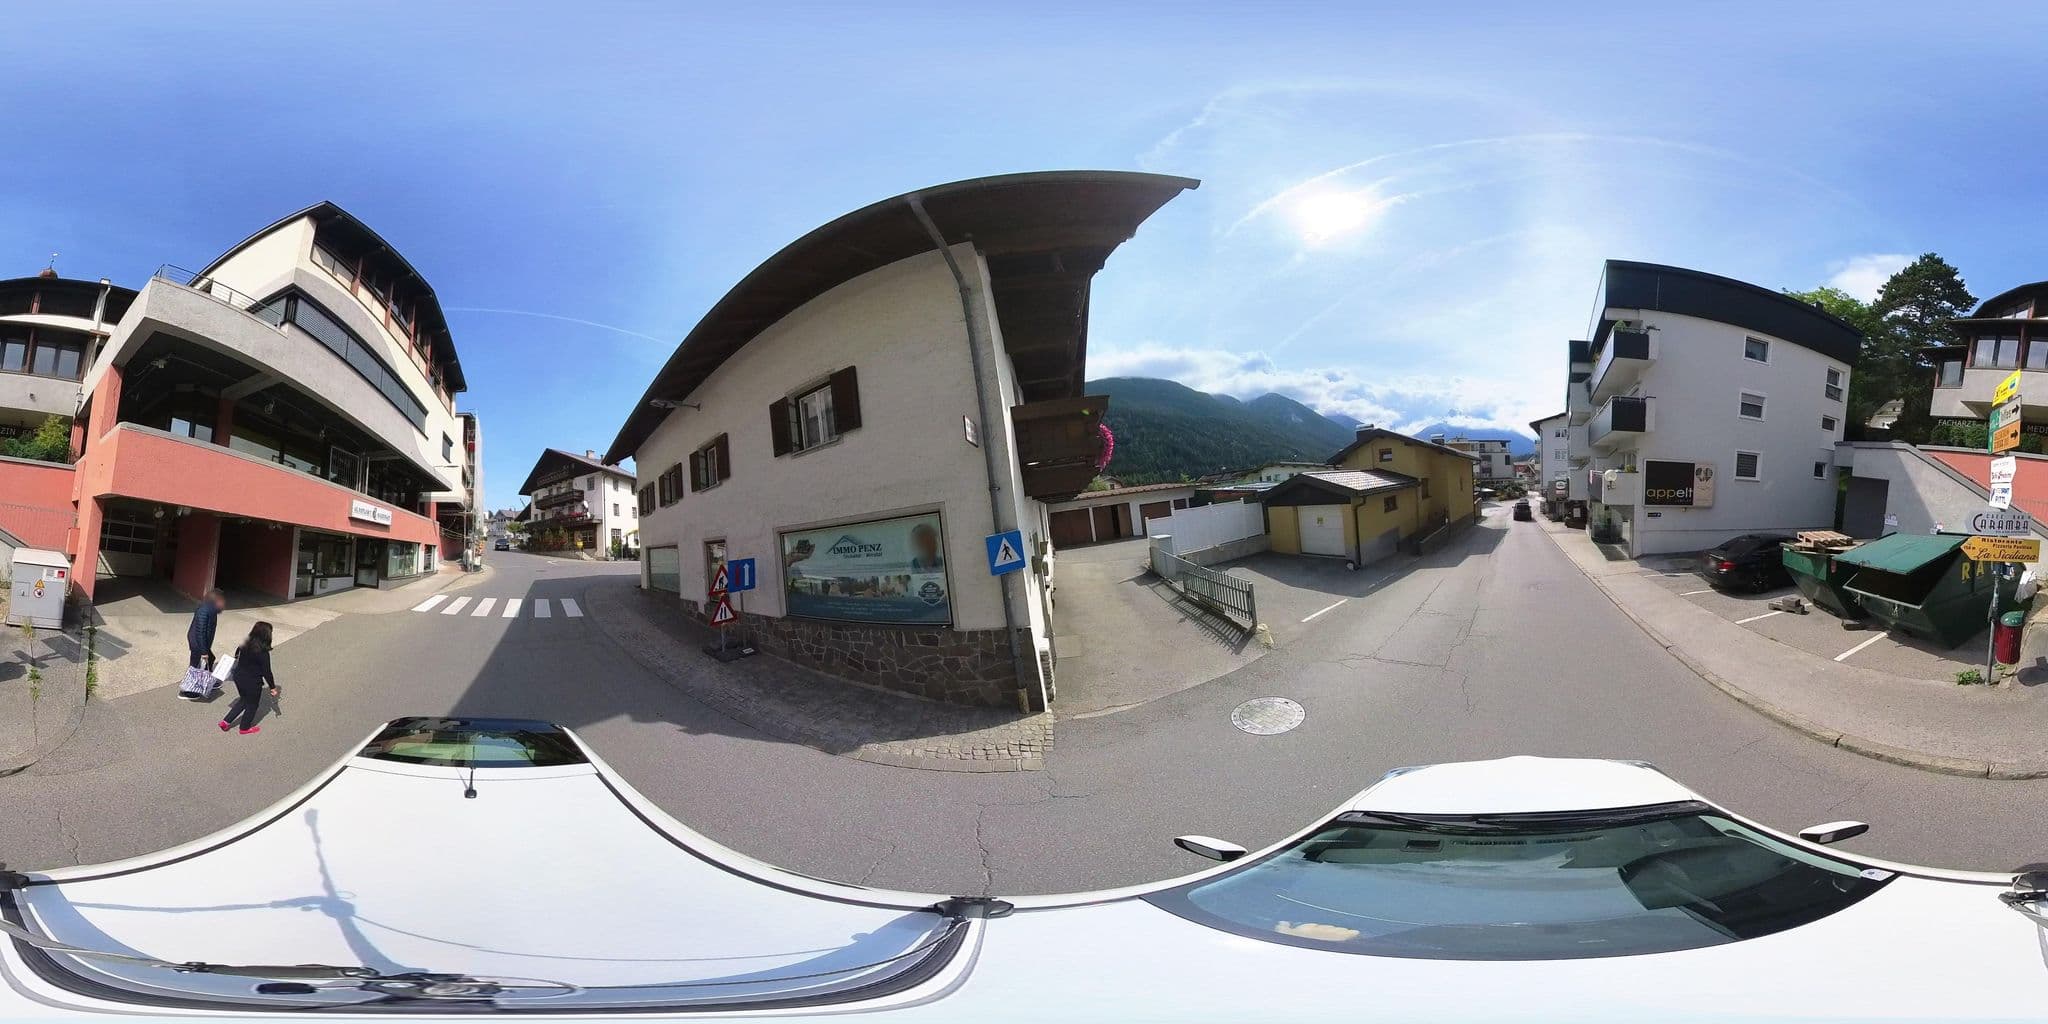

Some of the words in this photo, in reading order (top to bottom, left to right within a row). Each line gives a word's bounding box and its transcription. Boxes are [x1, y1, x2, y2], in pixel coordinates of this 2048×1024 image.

[1646, 487, 1693, 499] appelt
[1973, 513, 2029, 532] CARAMBA
[833, 545, 857, 554] IMMO
[858, 544, 882, 553] PENZ
[1993, 548, 2038, 560] Siciliana
